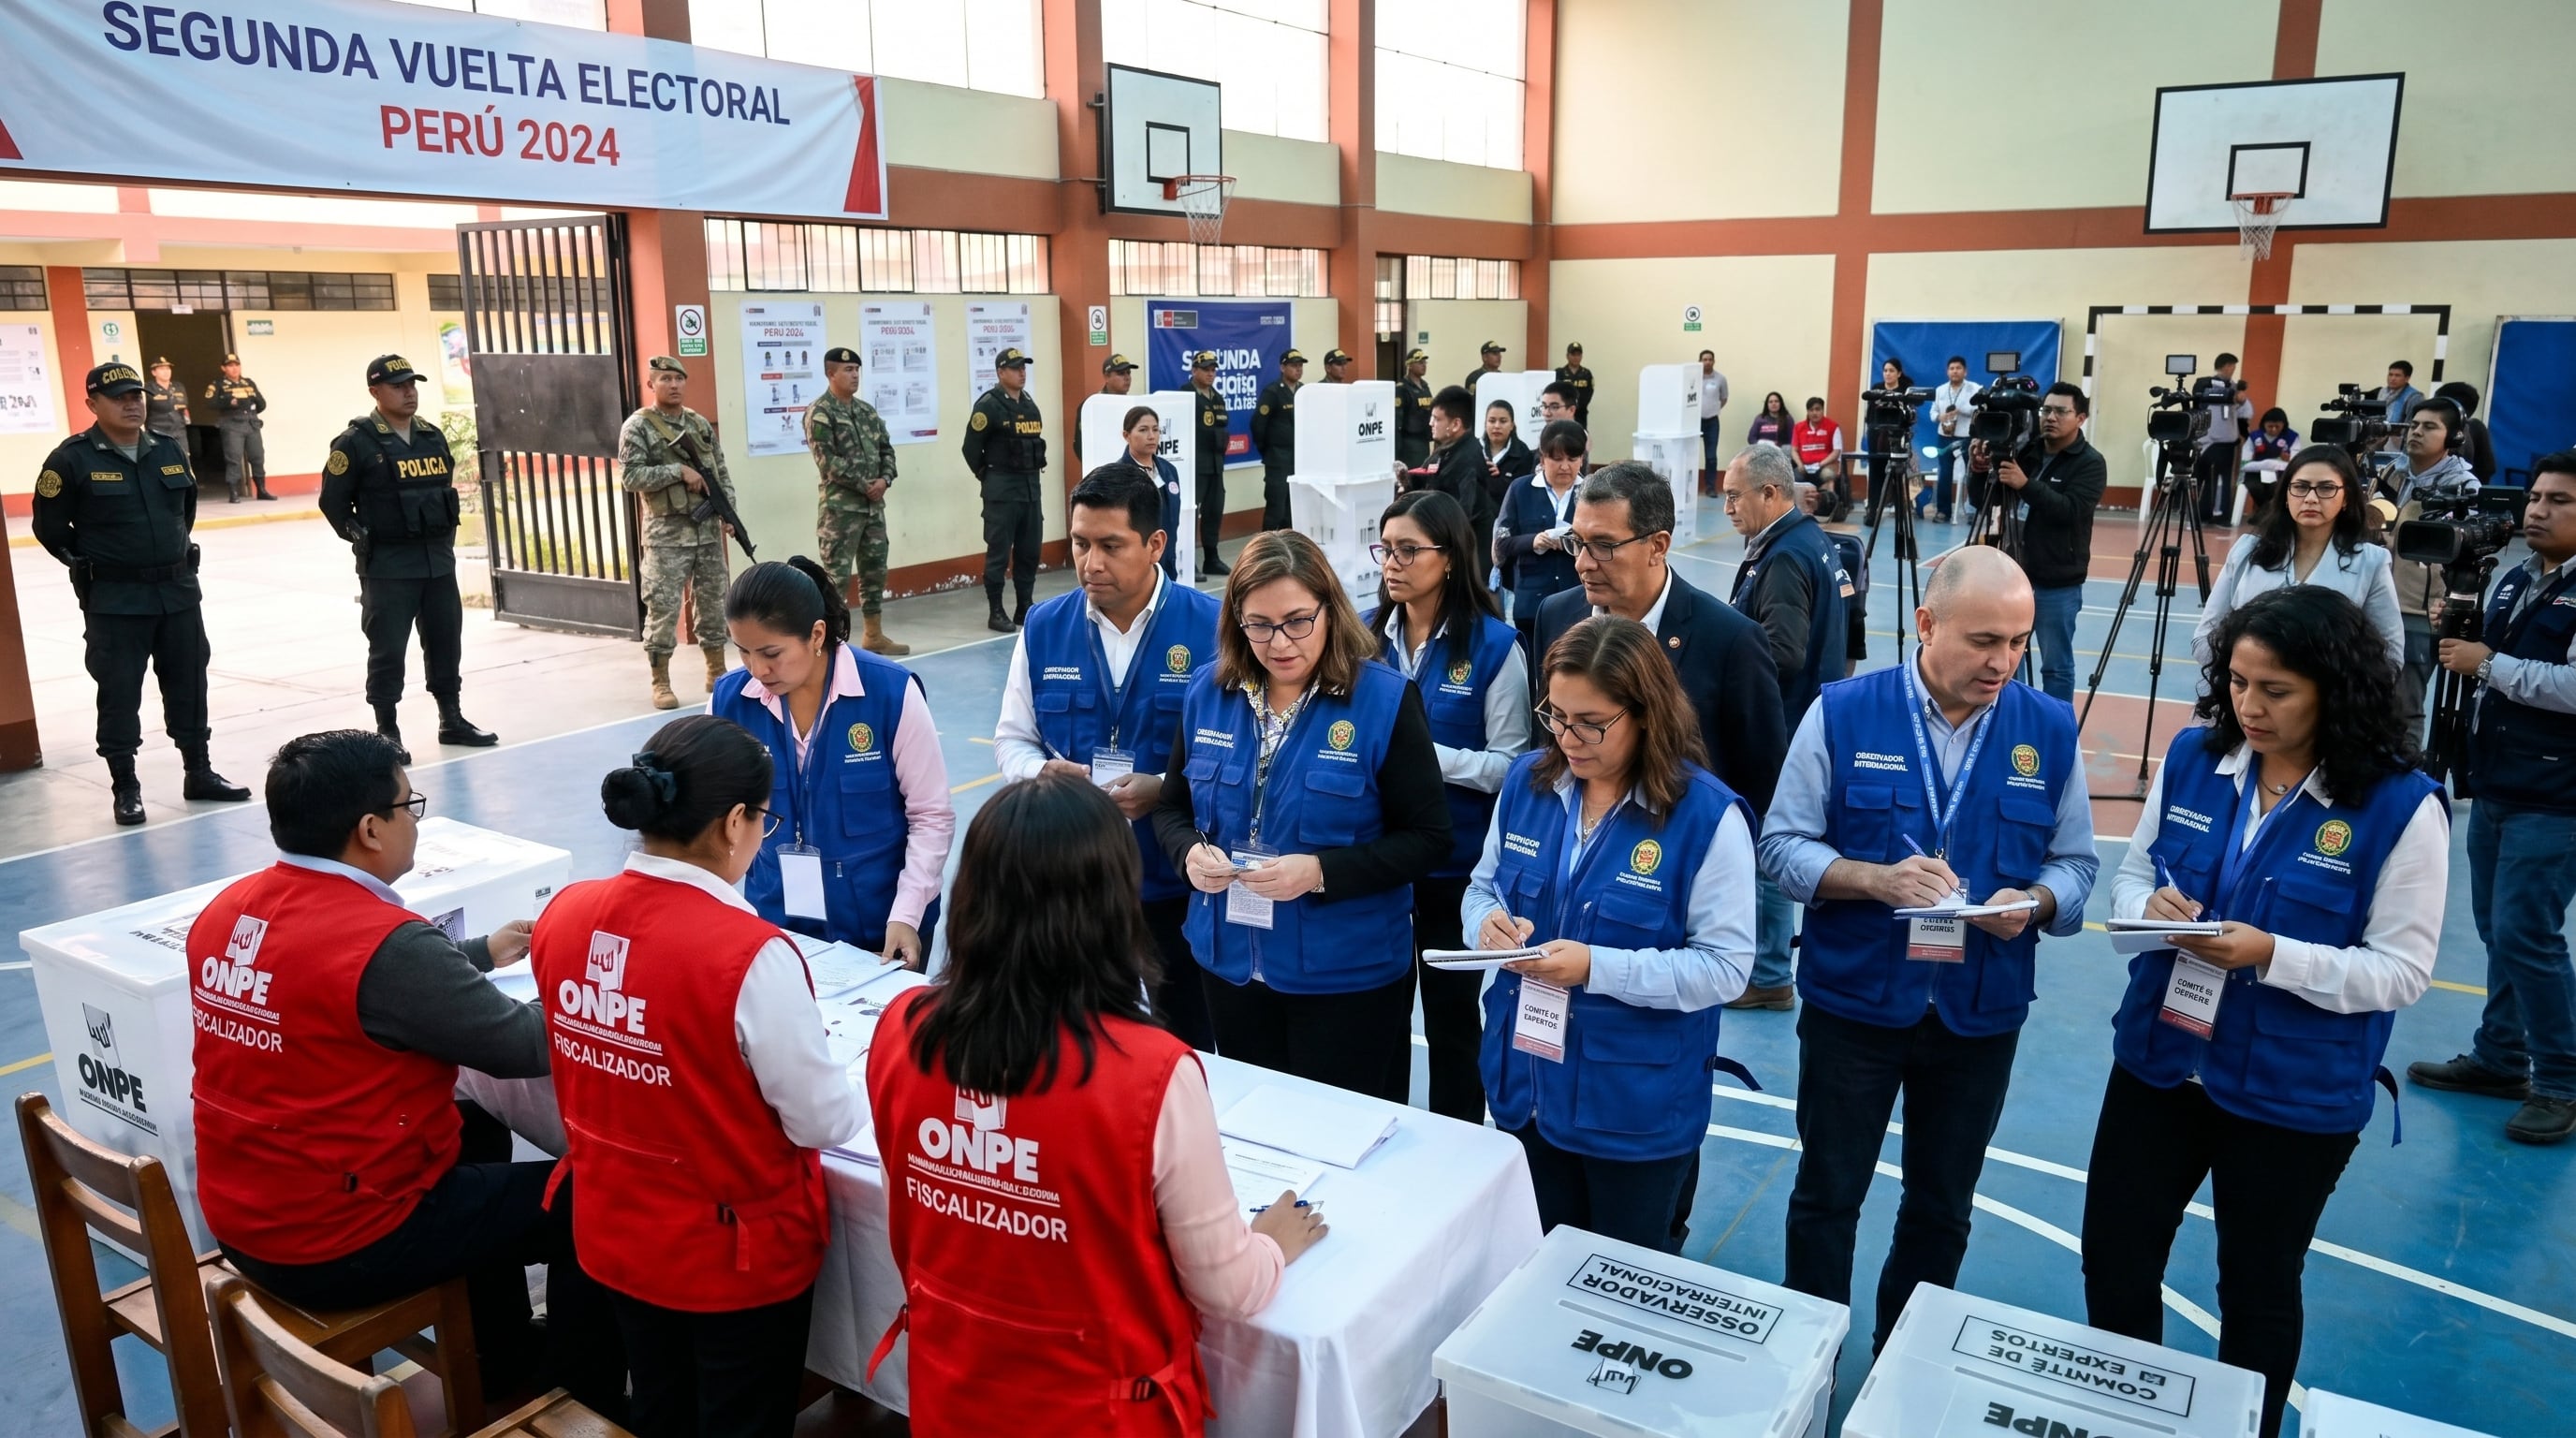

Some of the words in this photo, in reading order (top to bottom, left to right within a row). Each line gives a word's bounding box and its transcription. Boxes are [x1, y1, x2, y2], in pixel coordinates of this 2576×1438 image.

[103, 1, 379, 80] SEGUNDA
[388, 38, 566, 100] VUELTA
[578, 62, 791, 125] ELECTORAL
[379, 105, 504, 157] PERÚ
[517, 118, 621, 167] 2024
[1156, 439, 1179, 455] NPE
[1358, 420, 1383, 436] ONPE
[397, 457, 448, 478] POLICA
[202, 956, 273, 1005] ONPE
[559, 979, 646, 1035] ONPE
[2177, 978, 2204, 993] COMITÉ
[1525, 1004, 1549, 1018] COMITÉ
[1550, 1012, 1559, 1020] DE
[79, 1052, 147, 1113] ONPE
[554, 1032, 672, 1087] FISCALIZADOR
[918, 1117, 1039, 1183] ONPE
[906, 1176, 1068, 1243] FISCALIZADOR
[1582, 1272, 1760, 1336] OSSERVADOR
[1599, 1261, 1767, 1319] INTERRACIONAL
[1571, 1328, 1693, 1380] ONPE
[1988, 1344, 2023, 1364] DE
[1992, 1329, 2126, 1375] EXPERTOS
